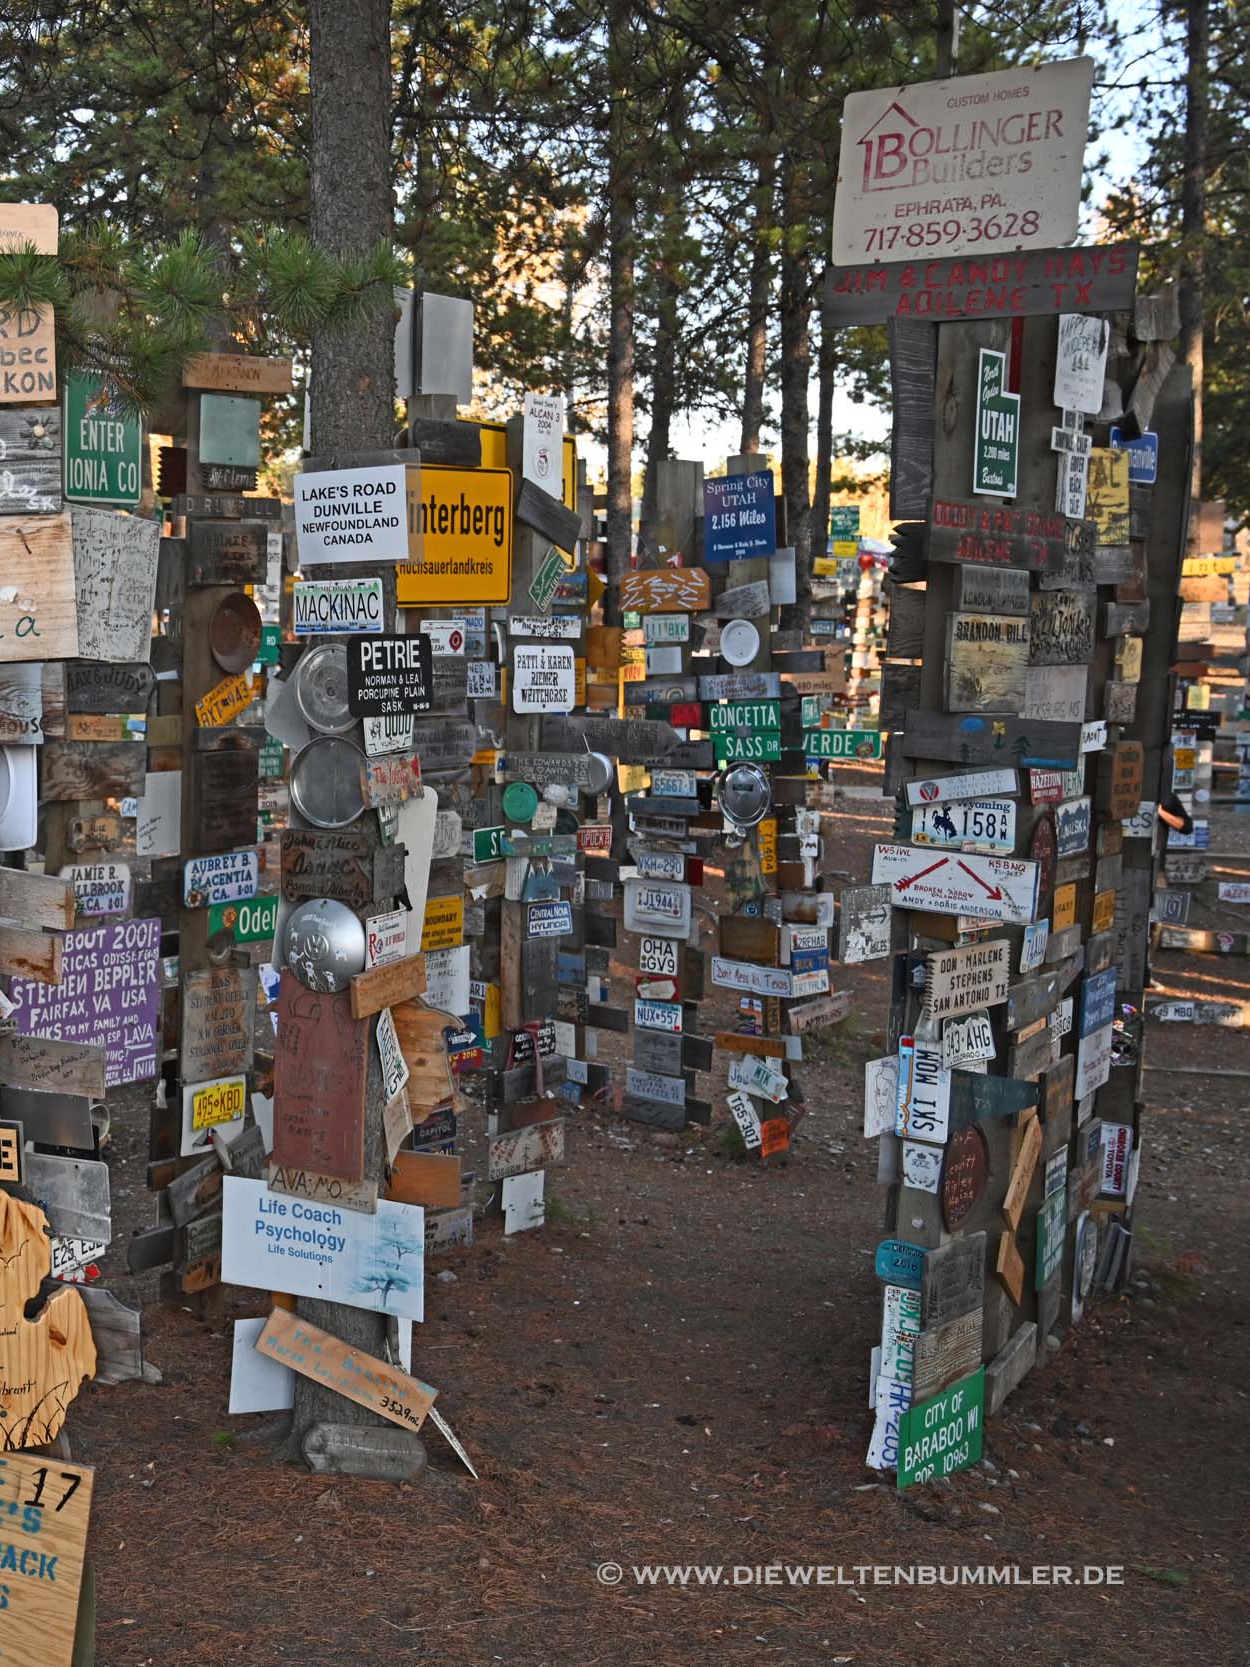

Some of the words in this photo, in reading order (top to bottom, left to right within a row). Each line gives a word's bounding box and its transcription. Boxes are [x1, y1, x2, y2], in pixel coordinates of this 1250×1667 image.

[946, 92, 990, 109] CUSTOM
[992, 86, 1030, 103] HOMES
[876, 109, 1064, 182] BOLLINGER
[910, 150, 1033, 187] Builders
[894, 195, 978, 219] EPHRATA,
[980, 192, 1007, 210] PA.
[832, 268, 888, 296] JIM
[924, 256, 1028, 290] CANDY
[1044, 248, 1128, 277] HAYS
[1051, 282, 1094, 308] TX
[80, 419, 125, 453] ENTER
[982, 408, 1015, 443] UTAH
[69, 457, 109, 493] IONIA
[118, 462, 138, 493] CO
[706, 479, 744, 496] Spring
[747, 475, 770, 491] City
[302, 485, 349, 501] LAKE'S
[353, 481, 397, 497] ROAD
[721, 491, 757, 509] UTAH
[314, 500, 383, 518] DUNVILLE
[739, 509, 767, 527] Miles
[302, 516, 399, 533] NEWFOUNDLAND
[324, 532, 374, 547] CANADA
[295, 591, 380, 622] MACKINAC
[361, 639, 421, 672] PETRIE
[517, 655, 538, 670] PATTI
[547, 655, 572, 671] KAREN
[365, 673, 397, 686] NORMAN
[358, 687, 400, 701] PORCUPINE
[404, 685, 426, 698] PLAIN
[381, 701, 406, 713] SASK.
[710, 704, 778, 728] CONCETTA
[725, 735, 764, 758] SASS
[766, 739, 780, 752] DR
[962, 810, 997, 839] 158
[530, 906, 554, 920] CENTRAL
[554, 905, 569, 918] NOVA
[902, 894, 925, 906] ANDY
[934, 899, 959, 912] DORIS
[960, 903, 1003, 919] ANDERSON
[530, 920, 569, 931] HYUNDAI
[94, 961, 158, 992] BEPPLER
[950, 968, 994, 991] STEPHENS
[30, 998, 89, 1026] FAIRFAX,
[93, 996, 112, 1014] VA
[121, 990, 148, 1009] USA
[933, 997, 953, 1015] SAN
[953, 990, 990, 1010] ANTONIO
[995, 982, 1007, 999] TX
[259, 1197, 287, 1216] Life
[292, 1202, 342, 1226] Coach
[255, 1220, 346, 1253] Psychology
[268, 1243, 287, 1256] Life
[288, 1246, 333, 1264] Solutions
[924, 1399, 947, 1429] CITY
[951, 1389, 965, 1414] OF
[903, 1418, 964, 1474] BARABOO
[967, 1404, 979, 1434] WI
[942, 1441, 970, 1475] 10963
[24, 1466, 82, 1512] 17
